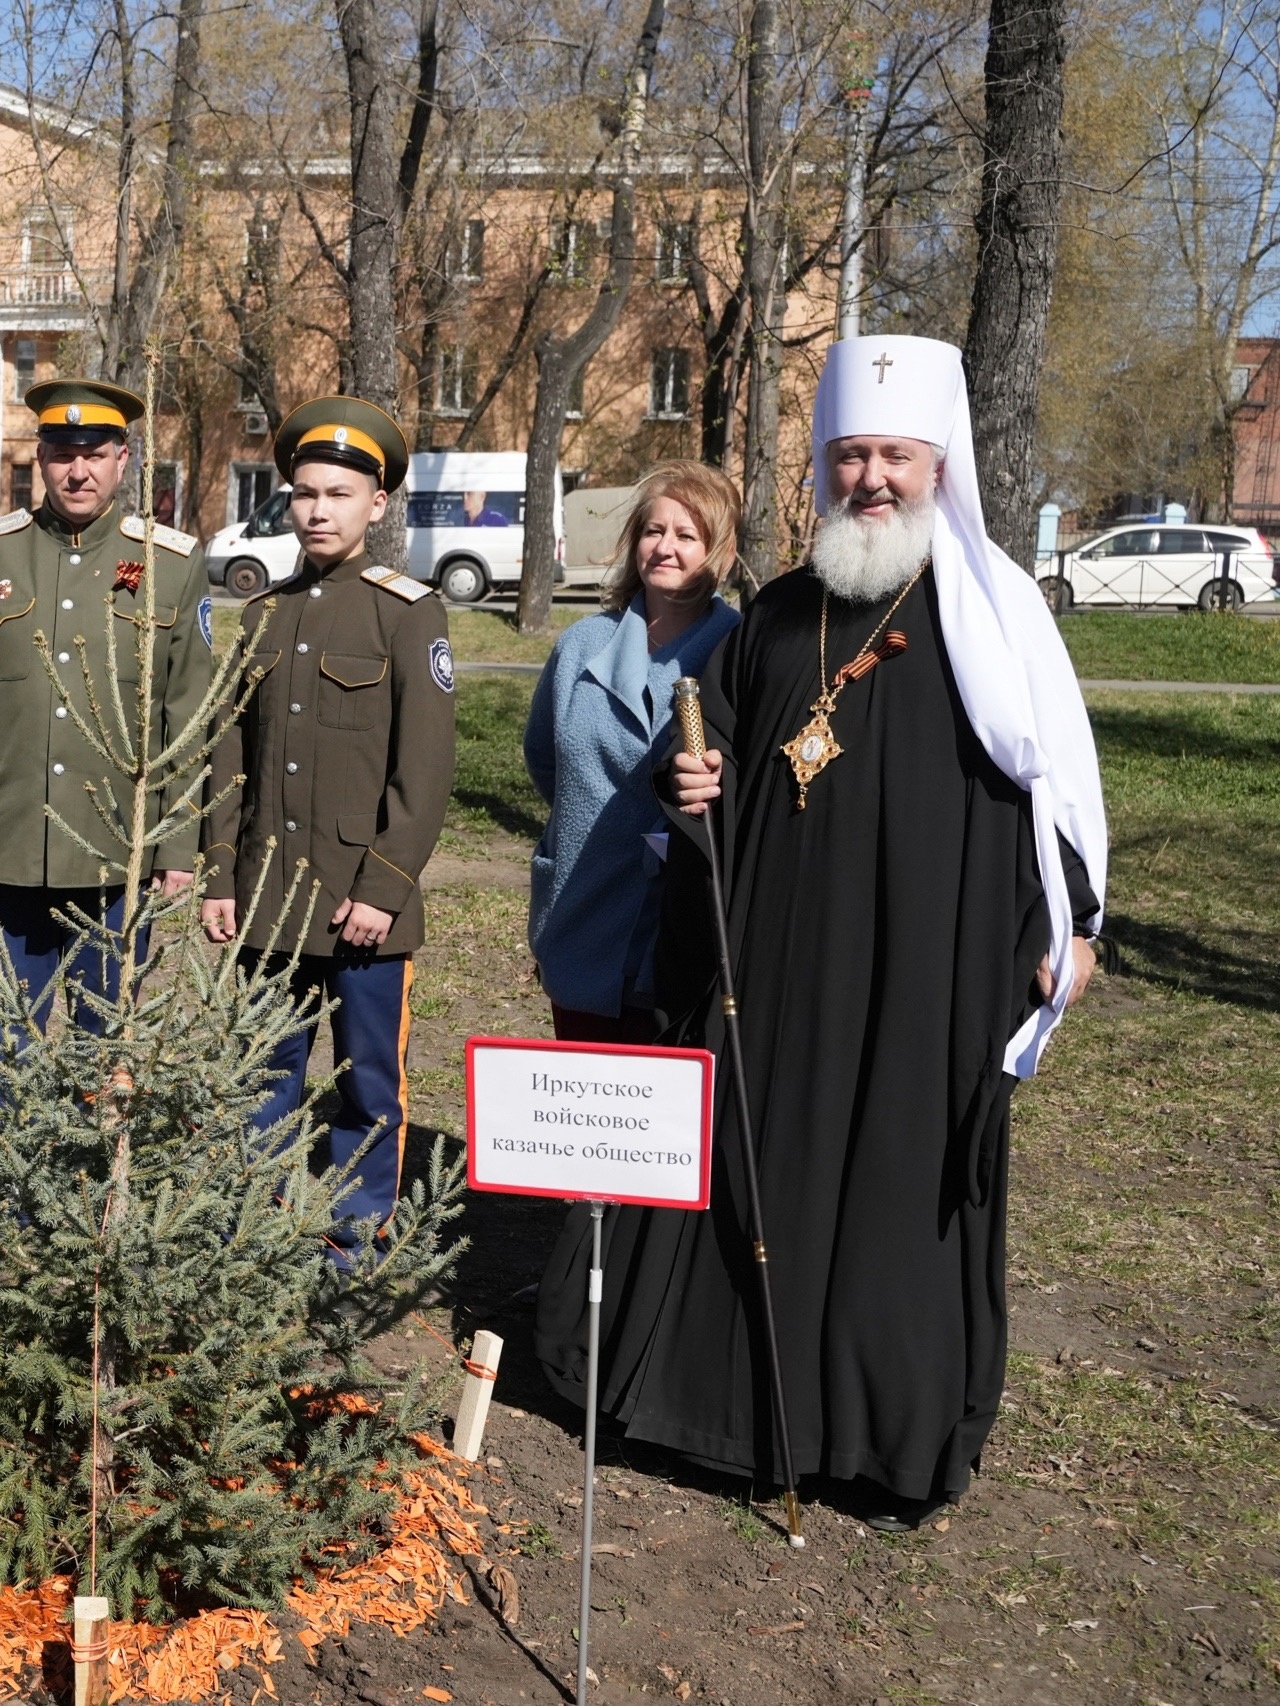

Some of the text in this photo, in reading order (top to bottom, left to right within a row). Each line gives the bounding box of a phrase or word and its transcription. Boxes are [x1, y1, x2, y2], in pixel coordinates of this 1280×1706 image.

[531, 1072, 653, 1099] Иркутское
[533, 1107, 650, 1131] войсковое
[492, 1136, 692, 1166] казачье общество
